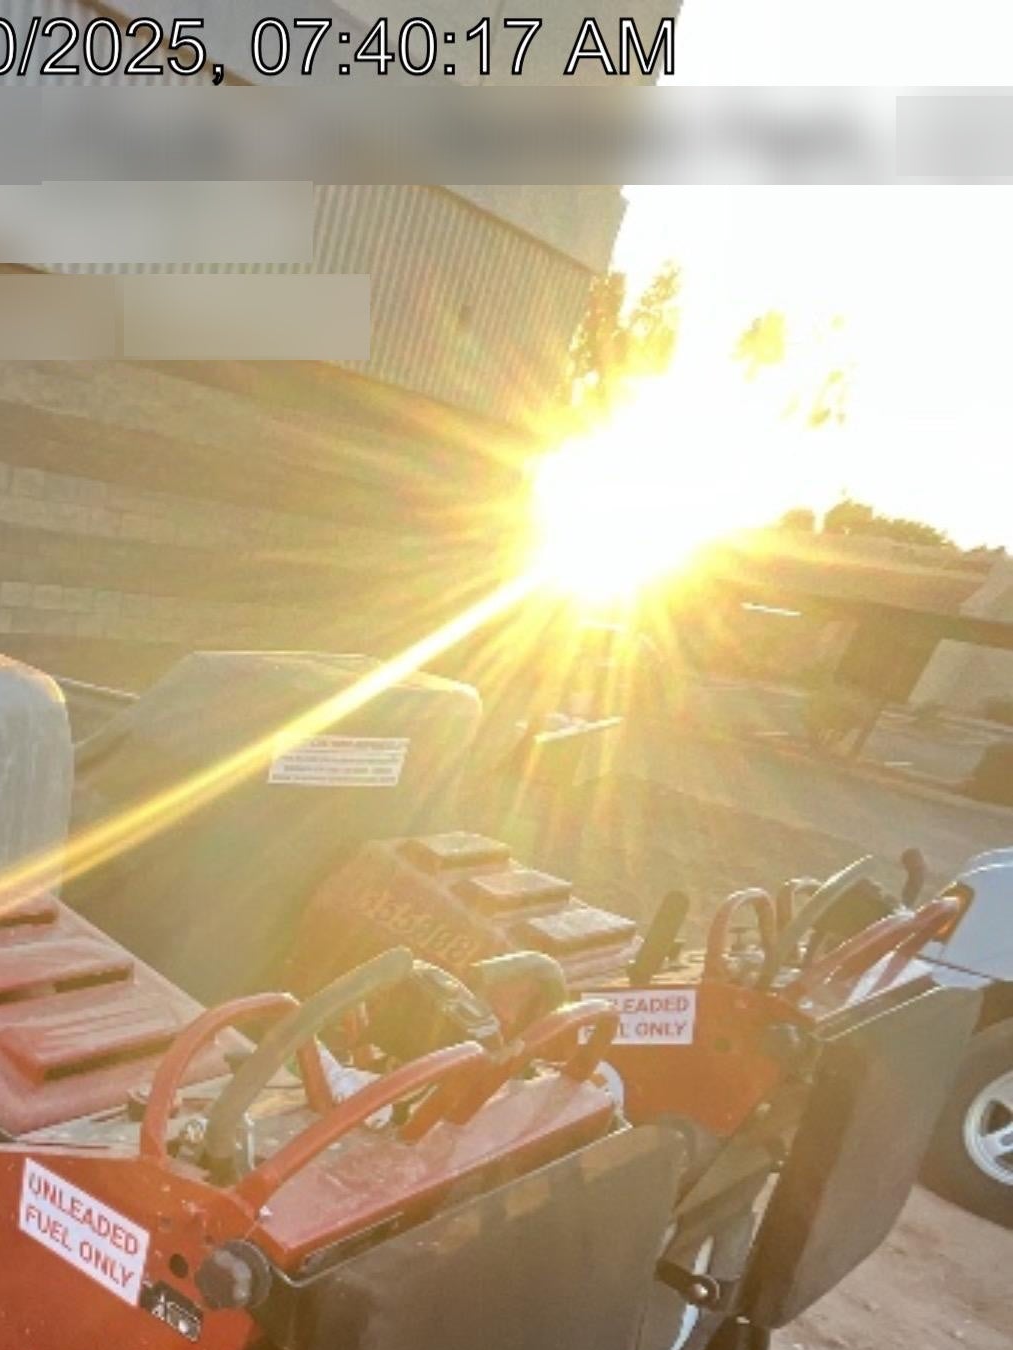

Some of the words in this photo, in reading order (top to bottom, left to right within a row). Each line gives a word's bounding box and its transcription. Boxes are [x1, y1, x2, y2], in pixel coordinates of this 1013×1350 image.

[635, 1022, 687, 1038] ONLY
[25, 1202, 73, 1252] FUEL
[79, 1240, 136, 1289] ONLY
[28, 1171, 139, 1256] UNLEADED
